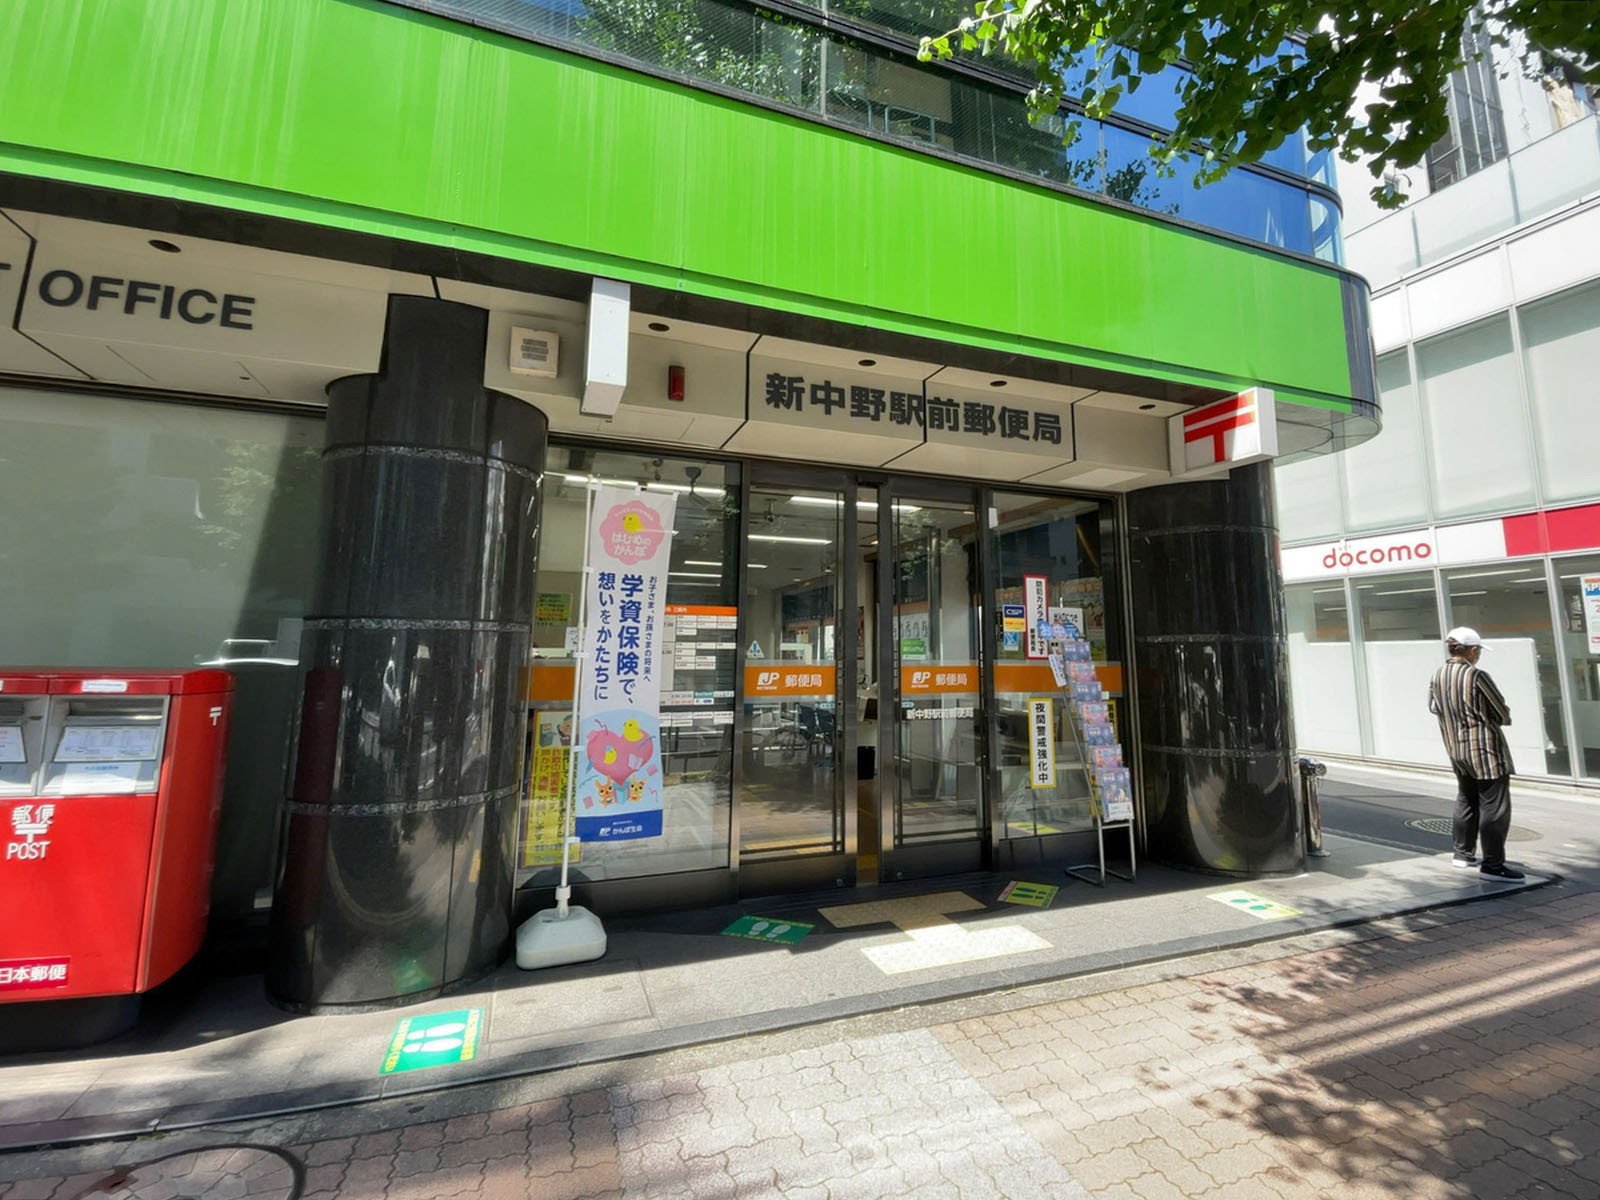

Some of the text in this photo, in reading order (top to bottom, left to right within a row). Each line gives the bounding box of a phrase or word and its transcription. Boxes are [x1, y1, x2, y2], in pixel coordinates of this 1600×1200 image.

[38, 269, 256, 331] OFFICE
[765, 372, 1062, 445] 新中野駅前郵便局
[1322, 542, 1432, 569] docomo
[594, 571, 616, 701] 想いをかたちに
[616, 573, 643, 704] 学資保険で、
[784, 673, 823, 688] 郵便局
[935, 672, 968, 686] 郵便局
[1034, 702, 1049, 783] 夜間警戒強化中
[12, 804, 56, 826] 郵便
[6, 841, 51, 860] POST
[0, 964, 67, 984] 日本郵便
